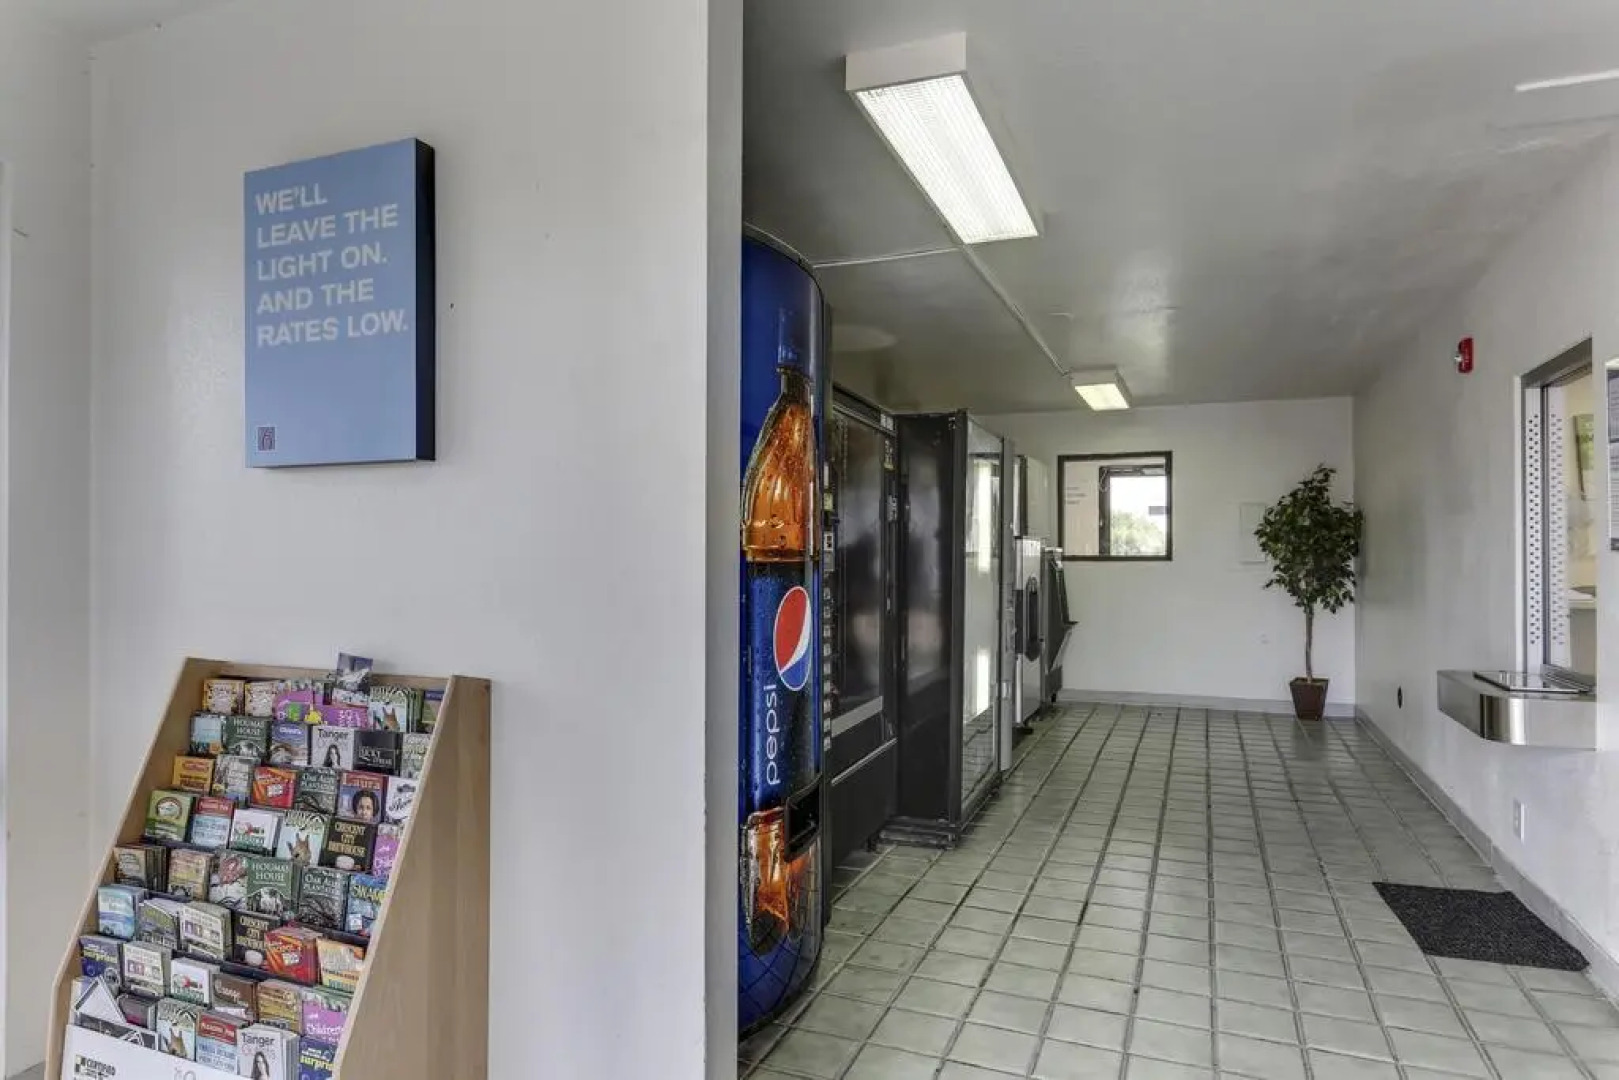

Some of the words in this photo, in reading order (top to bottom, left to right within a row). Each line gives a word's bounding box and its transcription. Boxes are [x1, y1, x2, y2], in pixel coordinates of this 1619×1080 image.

[256, 183, 327, 216] WE'LL
[257, 215, 336, 248] LEAVE
[344, 204, 399, 232] THE
[257, 250, 332, 281] LIGHT
[341, 242, 387, 269] ON.
[257, 288, 313, 314] AND
[322, 278, 374, 306] THE
[257, 317, 338, 347] RATES
[347, 309, 408, 337] LOW.
[318, 729, 349, 741] Tanger
[763, 685, 780, 785] pepsi
[256, 872, 285, 882] HOUSE
[242, 1032, 275, 1047] Tanger
